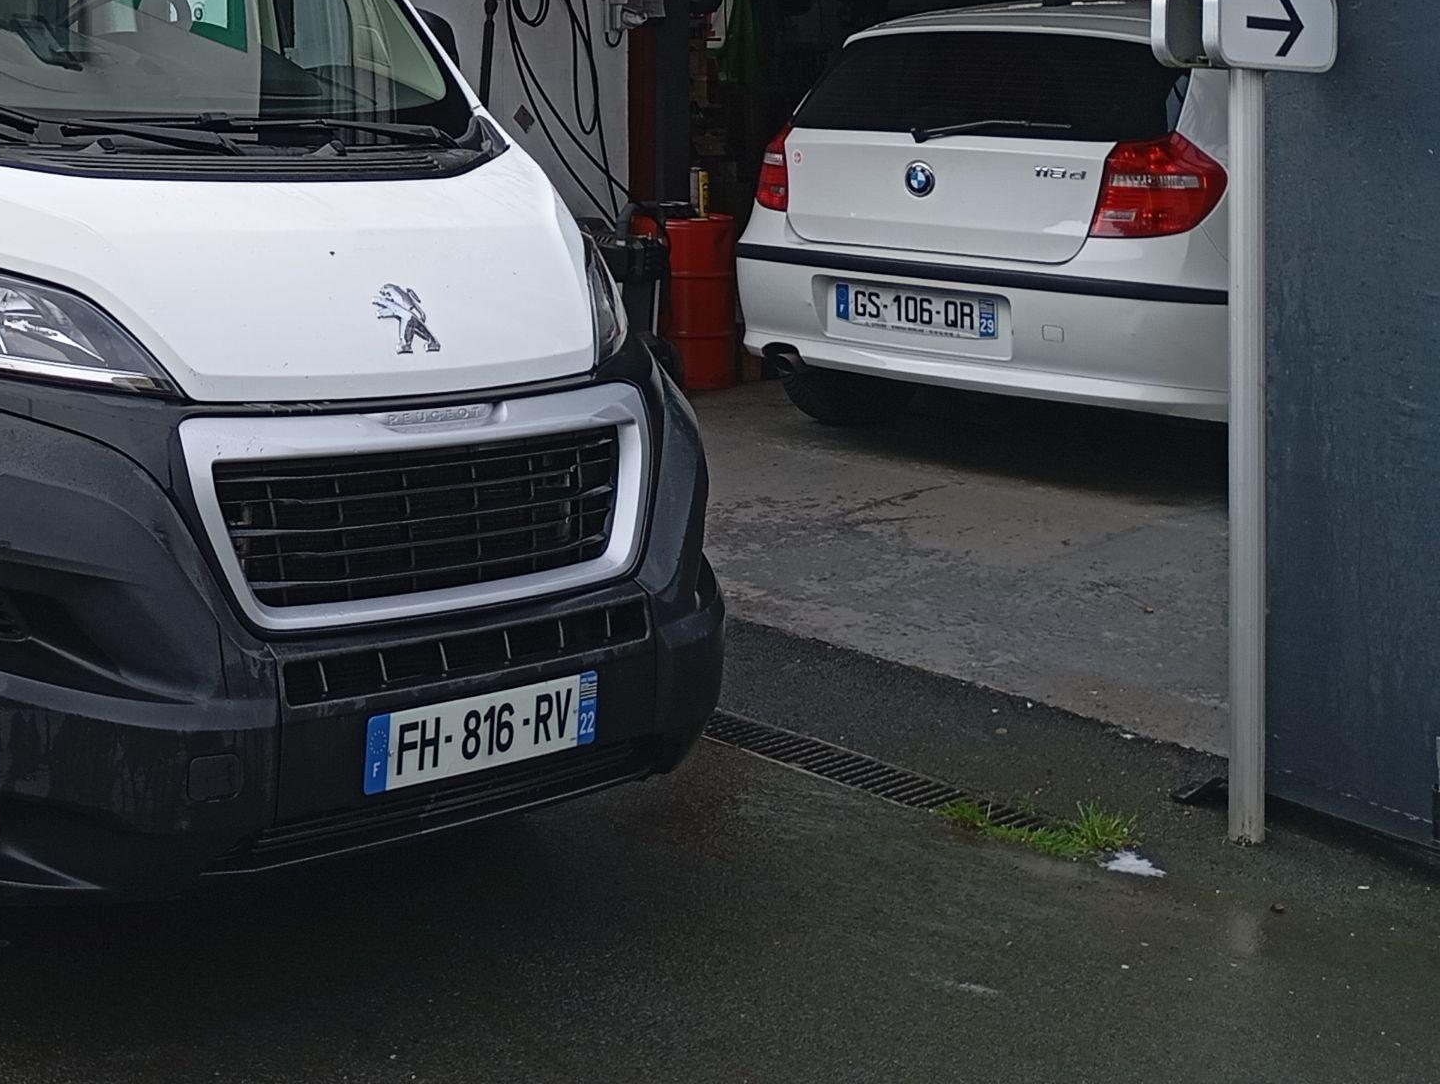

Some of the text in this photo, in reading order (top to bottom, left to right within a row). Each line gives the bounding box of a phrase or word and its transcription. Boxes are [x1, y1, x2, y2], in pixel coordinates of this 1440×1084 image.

[854, 290, 974, 330] GS-106-QR
[980, 318, 994, 333] 29
[387, 406, 480, 425] PEUGEOT
[372, 688, 595, 778] F FH-816-RV 22
